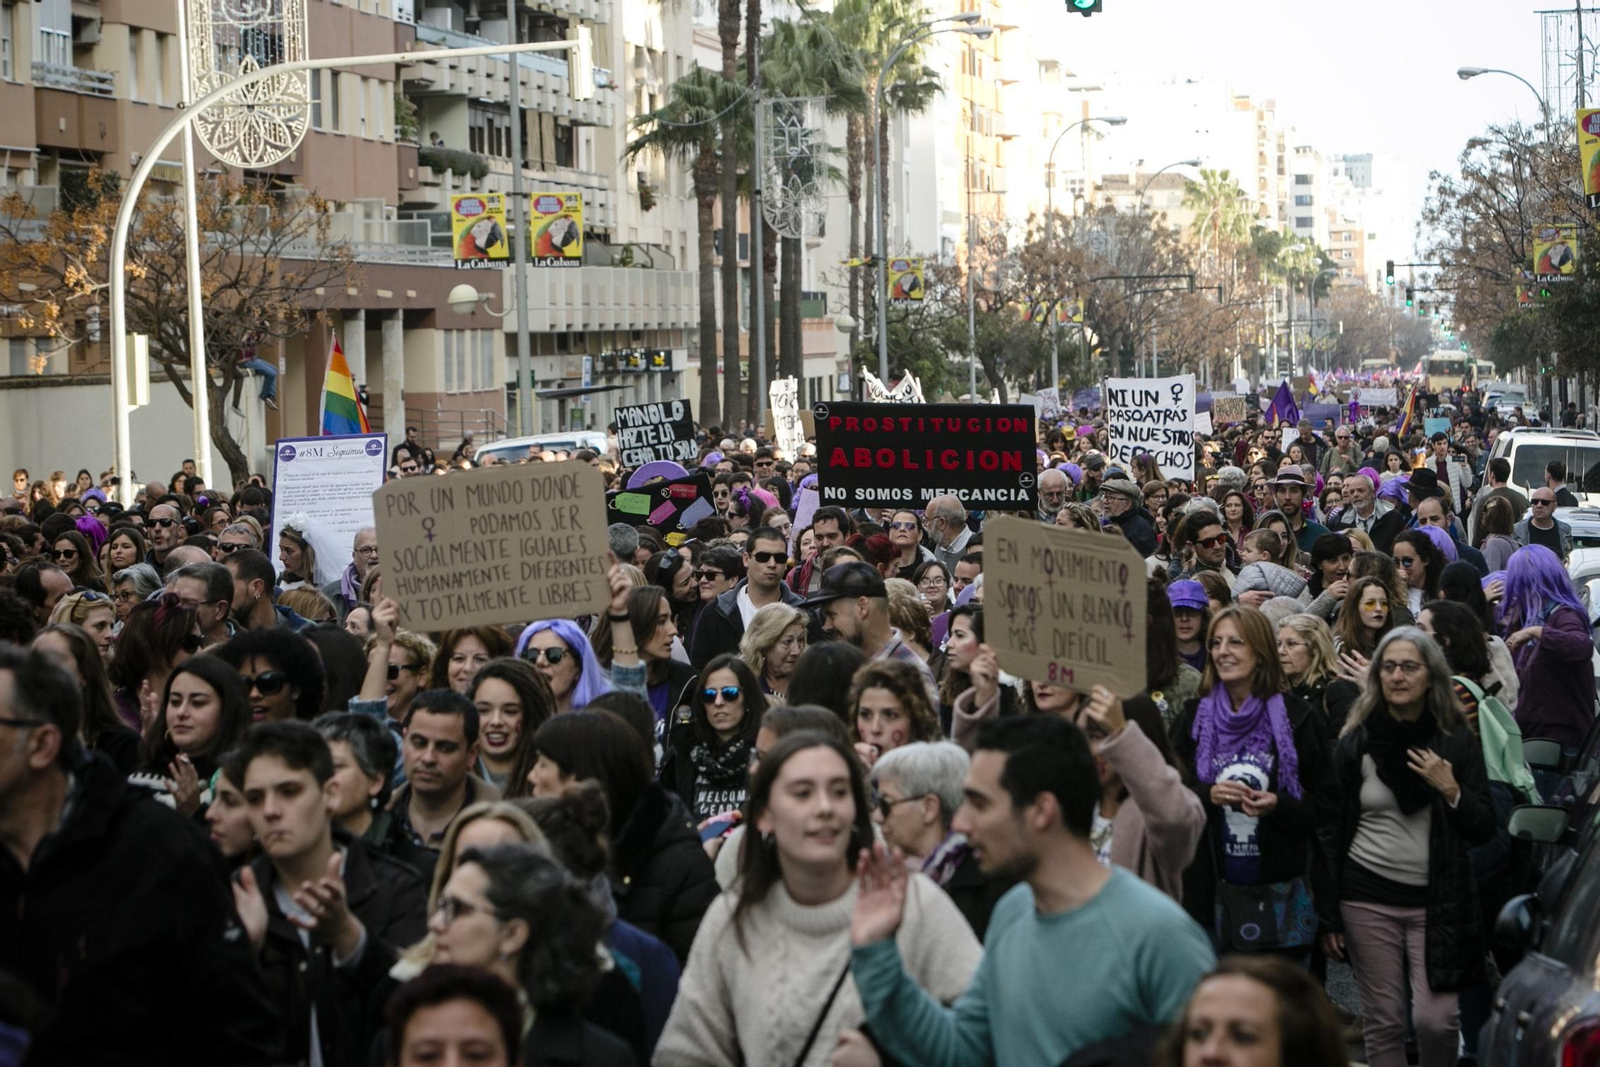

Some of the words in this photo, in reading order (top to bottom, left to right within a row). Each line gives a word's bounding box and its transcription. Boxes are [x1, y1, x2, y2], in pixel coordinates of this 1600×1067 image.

[457, 260, 471, 269] La
[471, 259, 508, 269] Cubana
[535, 257, 547, 267] La
[547, 257, 580, 267] Cubana
[1108, 388, 1128, 407] NI
[1131, 389, 1159, 407] UN
[615, 400, 684, 428] MANOLO
[829, 416, 1029, 433] PROSTITUCION
[618, 425, 659, 449] HAZTE
[658, 423, 675, 442] LA
[1110, 424, 1124, 439] EN
[1128, 426, 1194, 449] NUESTROS
[299, 447, 323, 458] #8M
[327, 445, 365, 459] Seguimos
[622, 446, 656, 468] CENA
[829, 447, 1023, 472] ABOLICION
[385, 491, 421, 518] POR
[430, 486, 454, 514] UN
[466, 479, 523, 510] MUNDO
[531, 471, 584, 502] DONDE
[824, 486, 847, 500] NO
[855, 487, 913, 501] SOMOS
[921, 488, 1030, 501] MERCANCIA
[470, 509, 542, 536] PODAMOS
[551, 504, 583, 532] SER
[392, 537, 512, 574] SOCIALMENTE
[520, 533, 588, 558] IGUALES
[996, 537, 1018, 564] EN
[1030, 545, 1129, 594] MOVIMIENTO
[396, 563, 511, 596] HUMANAMENTE
[521, 555, 605, 582] DIFERENTES
[400, 601, 413, 623] Y
[416, 585, 530, 621] TOTALMENTE
[538, 580, 593, 607] LIBRES
[998, 578, 1043, 626] SOMOS
[1051, 589, 1074, 620] UN
[698, 789, 746, 803] WELCOM
